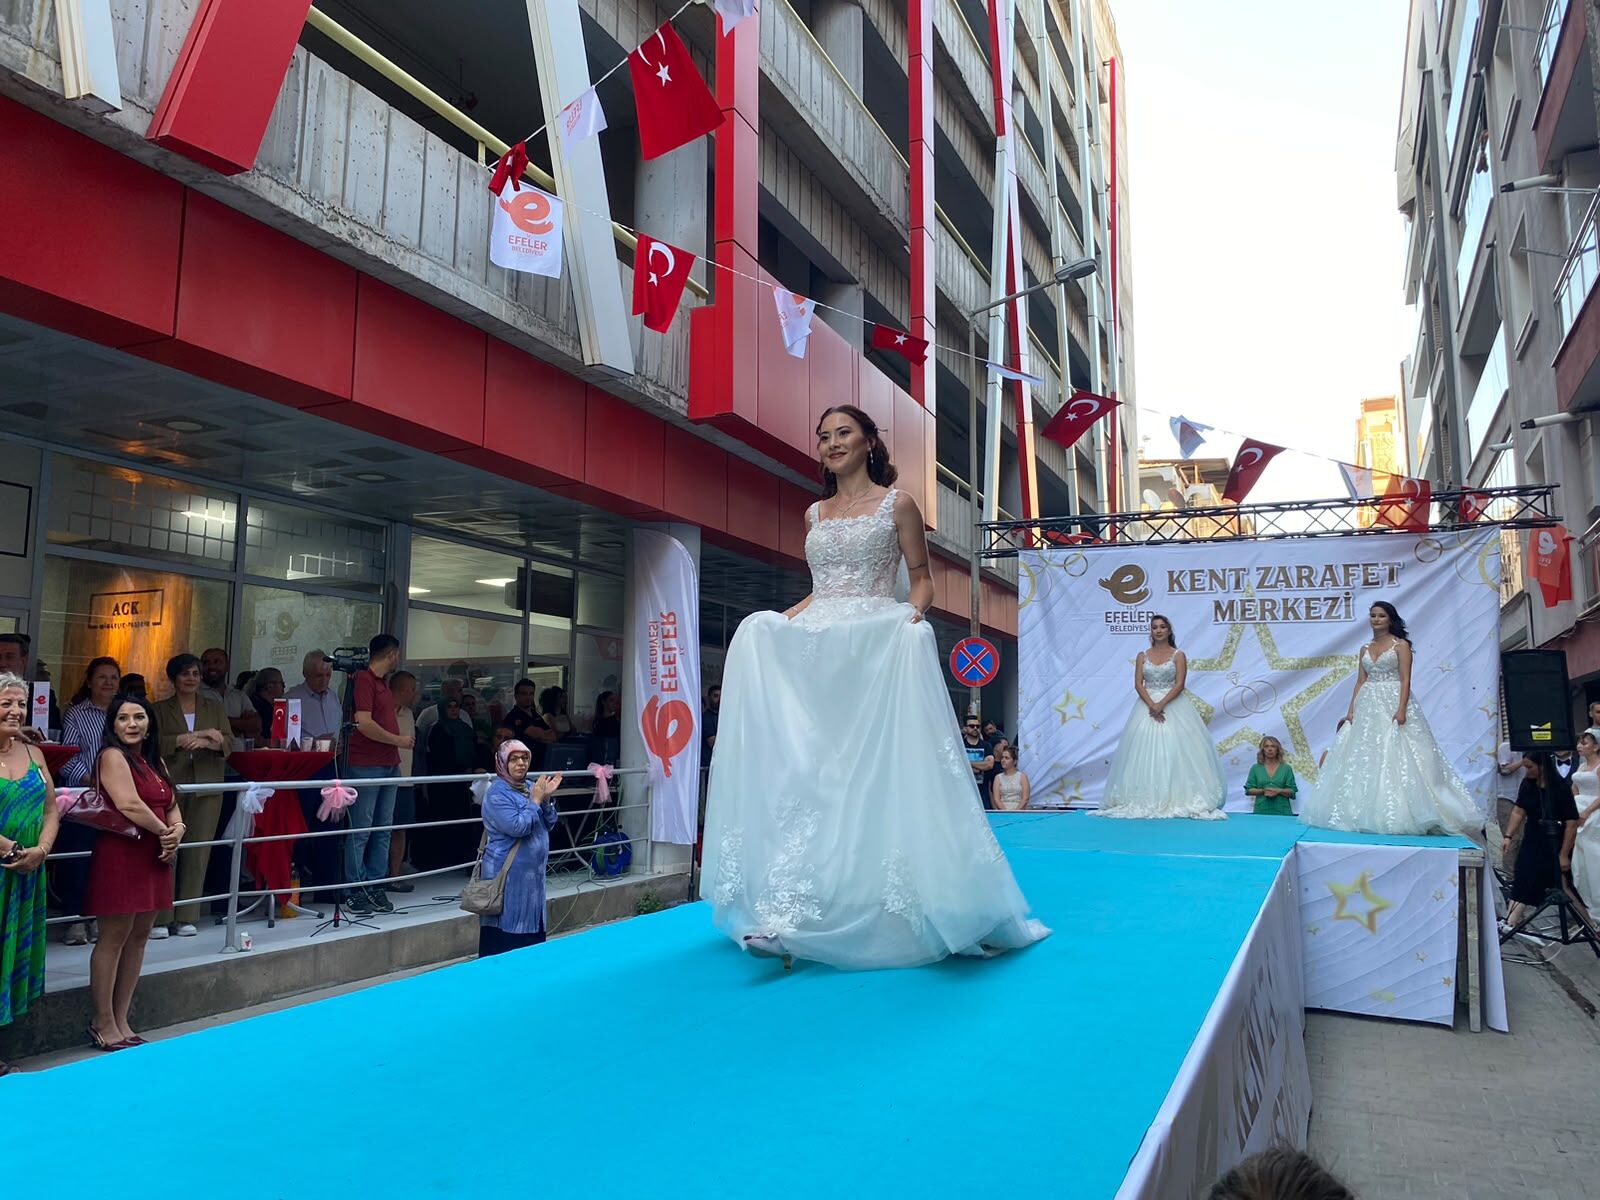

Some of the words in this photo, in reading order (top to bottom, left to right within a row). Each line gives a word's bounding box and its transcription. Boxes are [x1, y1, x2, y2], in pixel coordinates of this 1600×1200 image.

[508, 234, 548, 252] EFELER
[1167, 567, 1247, 593] KENT
[1255, 562, 1402, 590] ZARAFET
[112, 601, 140, 616] ACK
[1212, 591, 1354, 623] MERKEZİ
